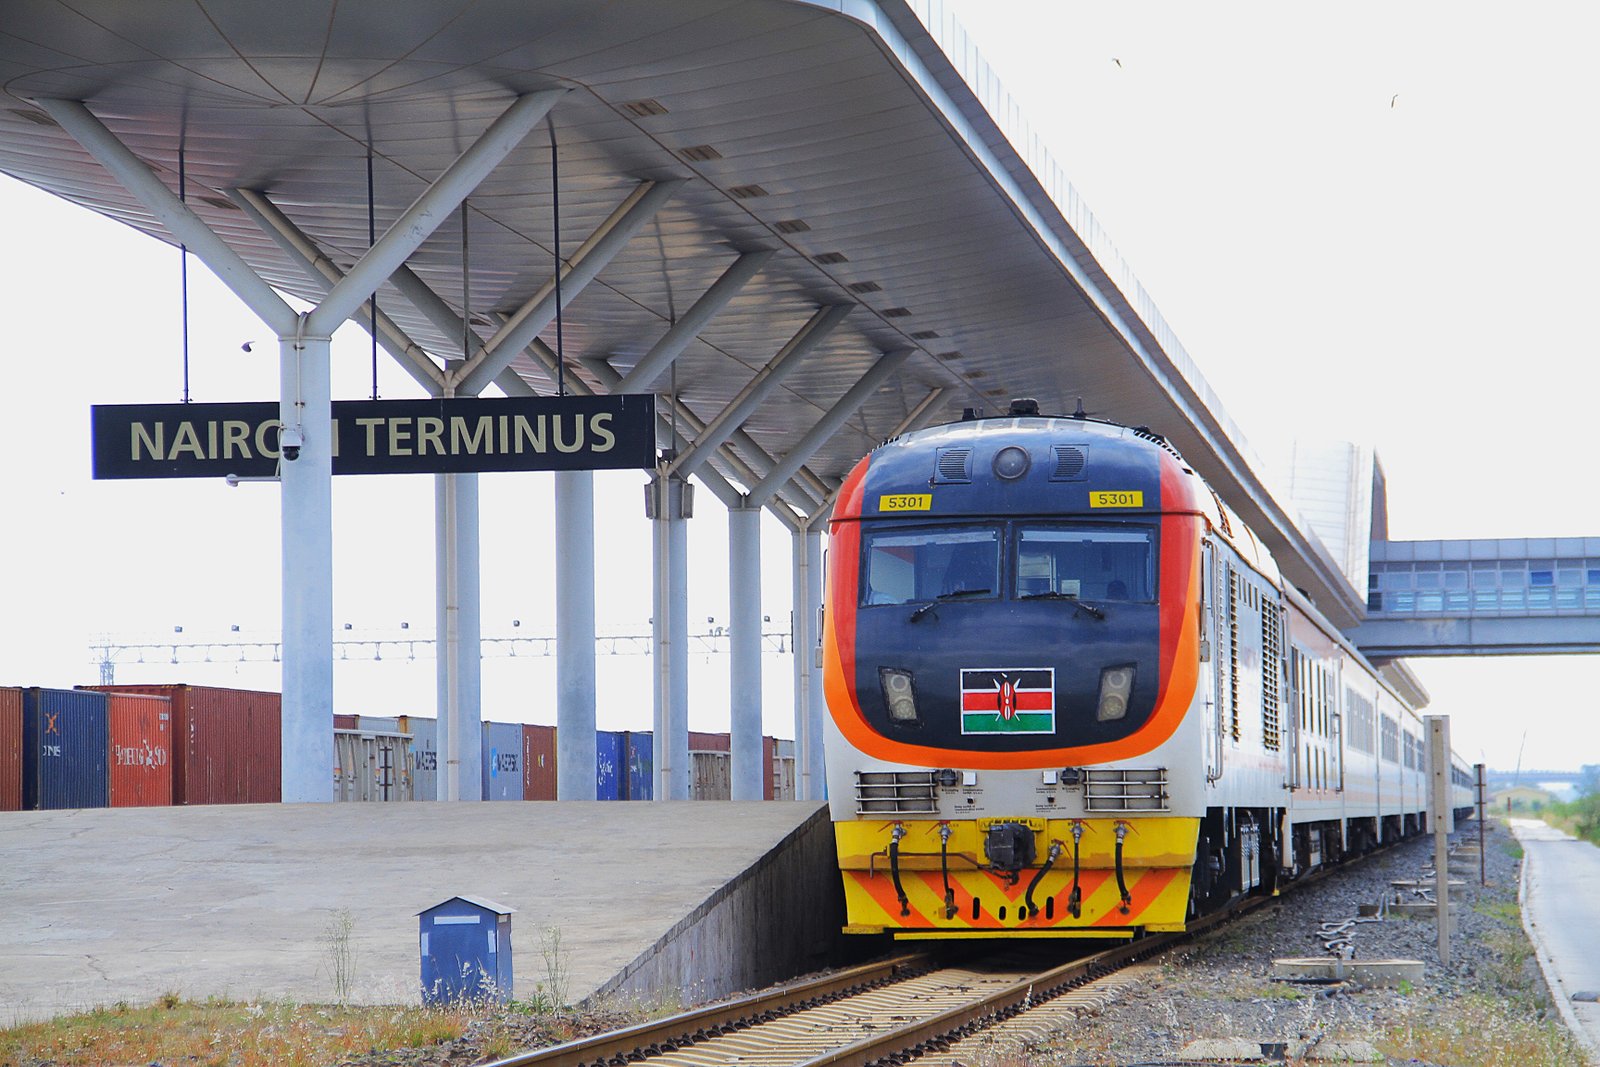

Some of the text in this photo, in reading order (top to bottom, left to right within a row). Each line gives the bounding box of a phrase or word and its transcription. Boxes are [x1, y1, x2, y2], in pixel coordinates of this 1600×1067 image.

[131, 412, 616, 461] NAIROI TERMINUS
[888, 496, 923, 508] 5301
[1099, 493, 1134, 505] 5301
